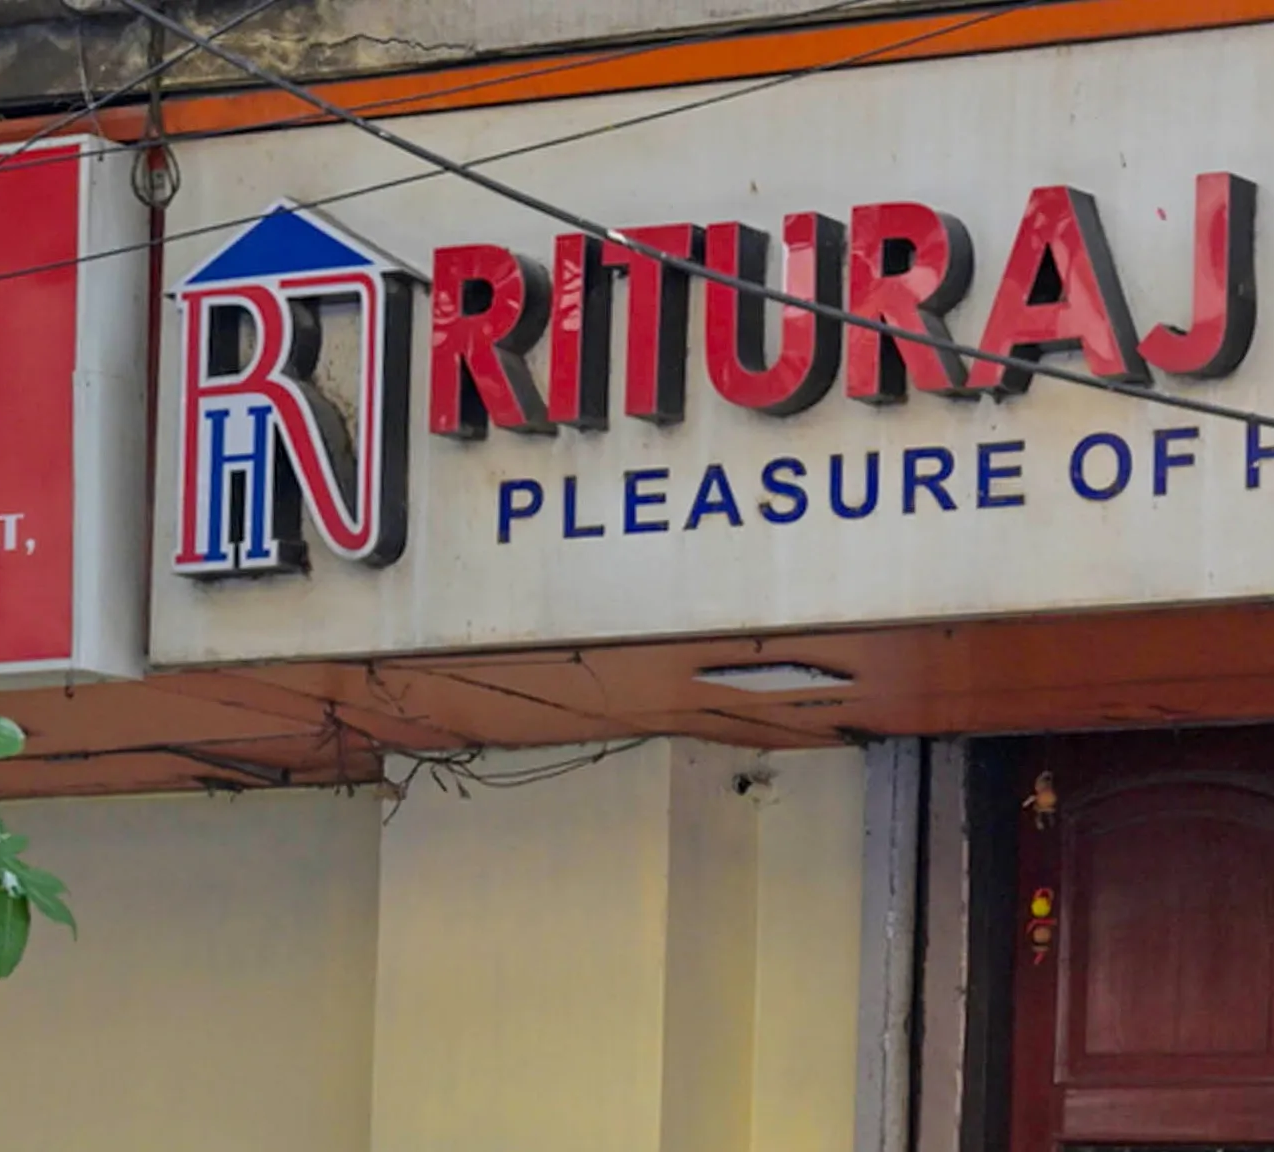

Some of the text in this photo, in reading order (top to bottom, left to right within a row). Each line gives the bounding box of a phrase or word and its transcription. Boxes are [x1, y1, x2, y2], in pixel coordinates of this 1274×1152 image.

[429, 171, 1255, 439] RITURAJ
[496, 440, 1027, 544] PLEASURE
[1067, 426, 1200, 502] OF
